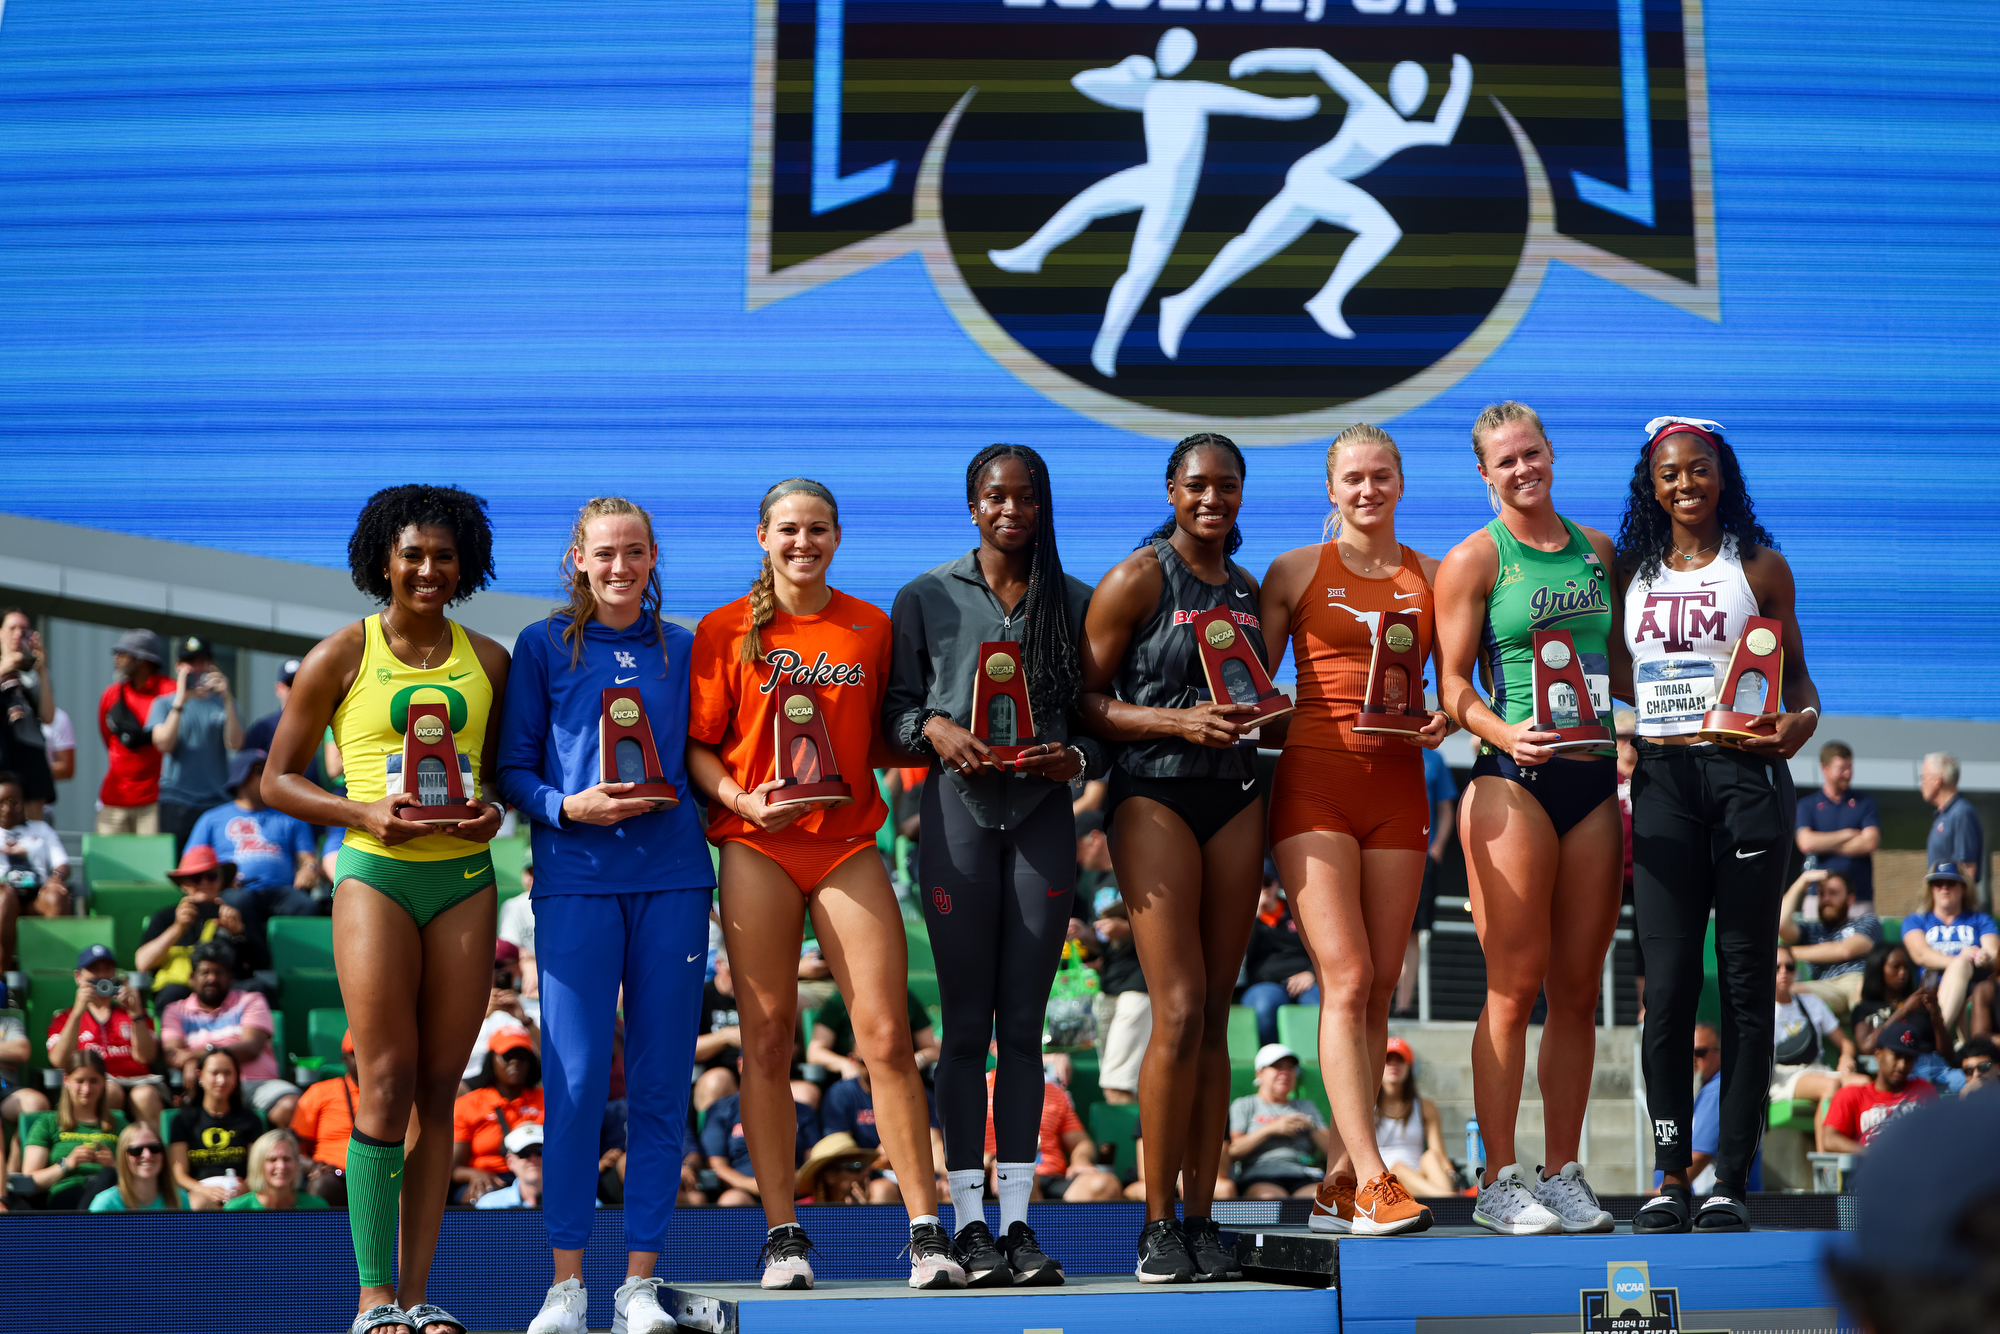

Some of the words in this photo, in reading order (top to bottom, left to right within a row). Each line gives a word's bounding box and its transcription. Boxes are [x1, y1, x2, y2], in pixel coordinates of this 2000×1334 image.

[1504, 572, 1524, 584] ACC
[1529, 577, 1609, 621] Irish
[1173, 609, 1207, 626] BA
[1229, 610, 1260, 630] TAT
[1210, 630, 1235, 645] NCAA
[613, 651, 638, 668] UK
[759, 648, 866, 694] Pokes
[988, 666, 1015, 675] NCAA
[1654, 683, 1692, 696] TIMARA
[788, 707, 813, 716] NCAA
[1646, 696, 1706, 715] CHAPMAN
[613, 710, 639, 719] NCAA
[417, 728, 444, 737] NCAA
[932, 886, 952, 914] OU
[1616, 1283, 1644, 1292] NCAA
[1612, 1320, 1636, 1328] 2024
